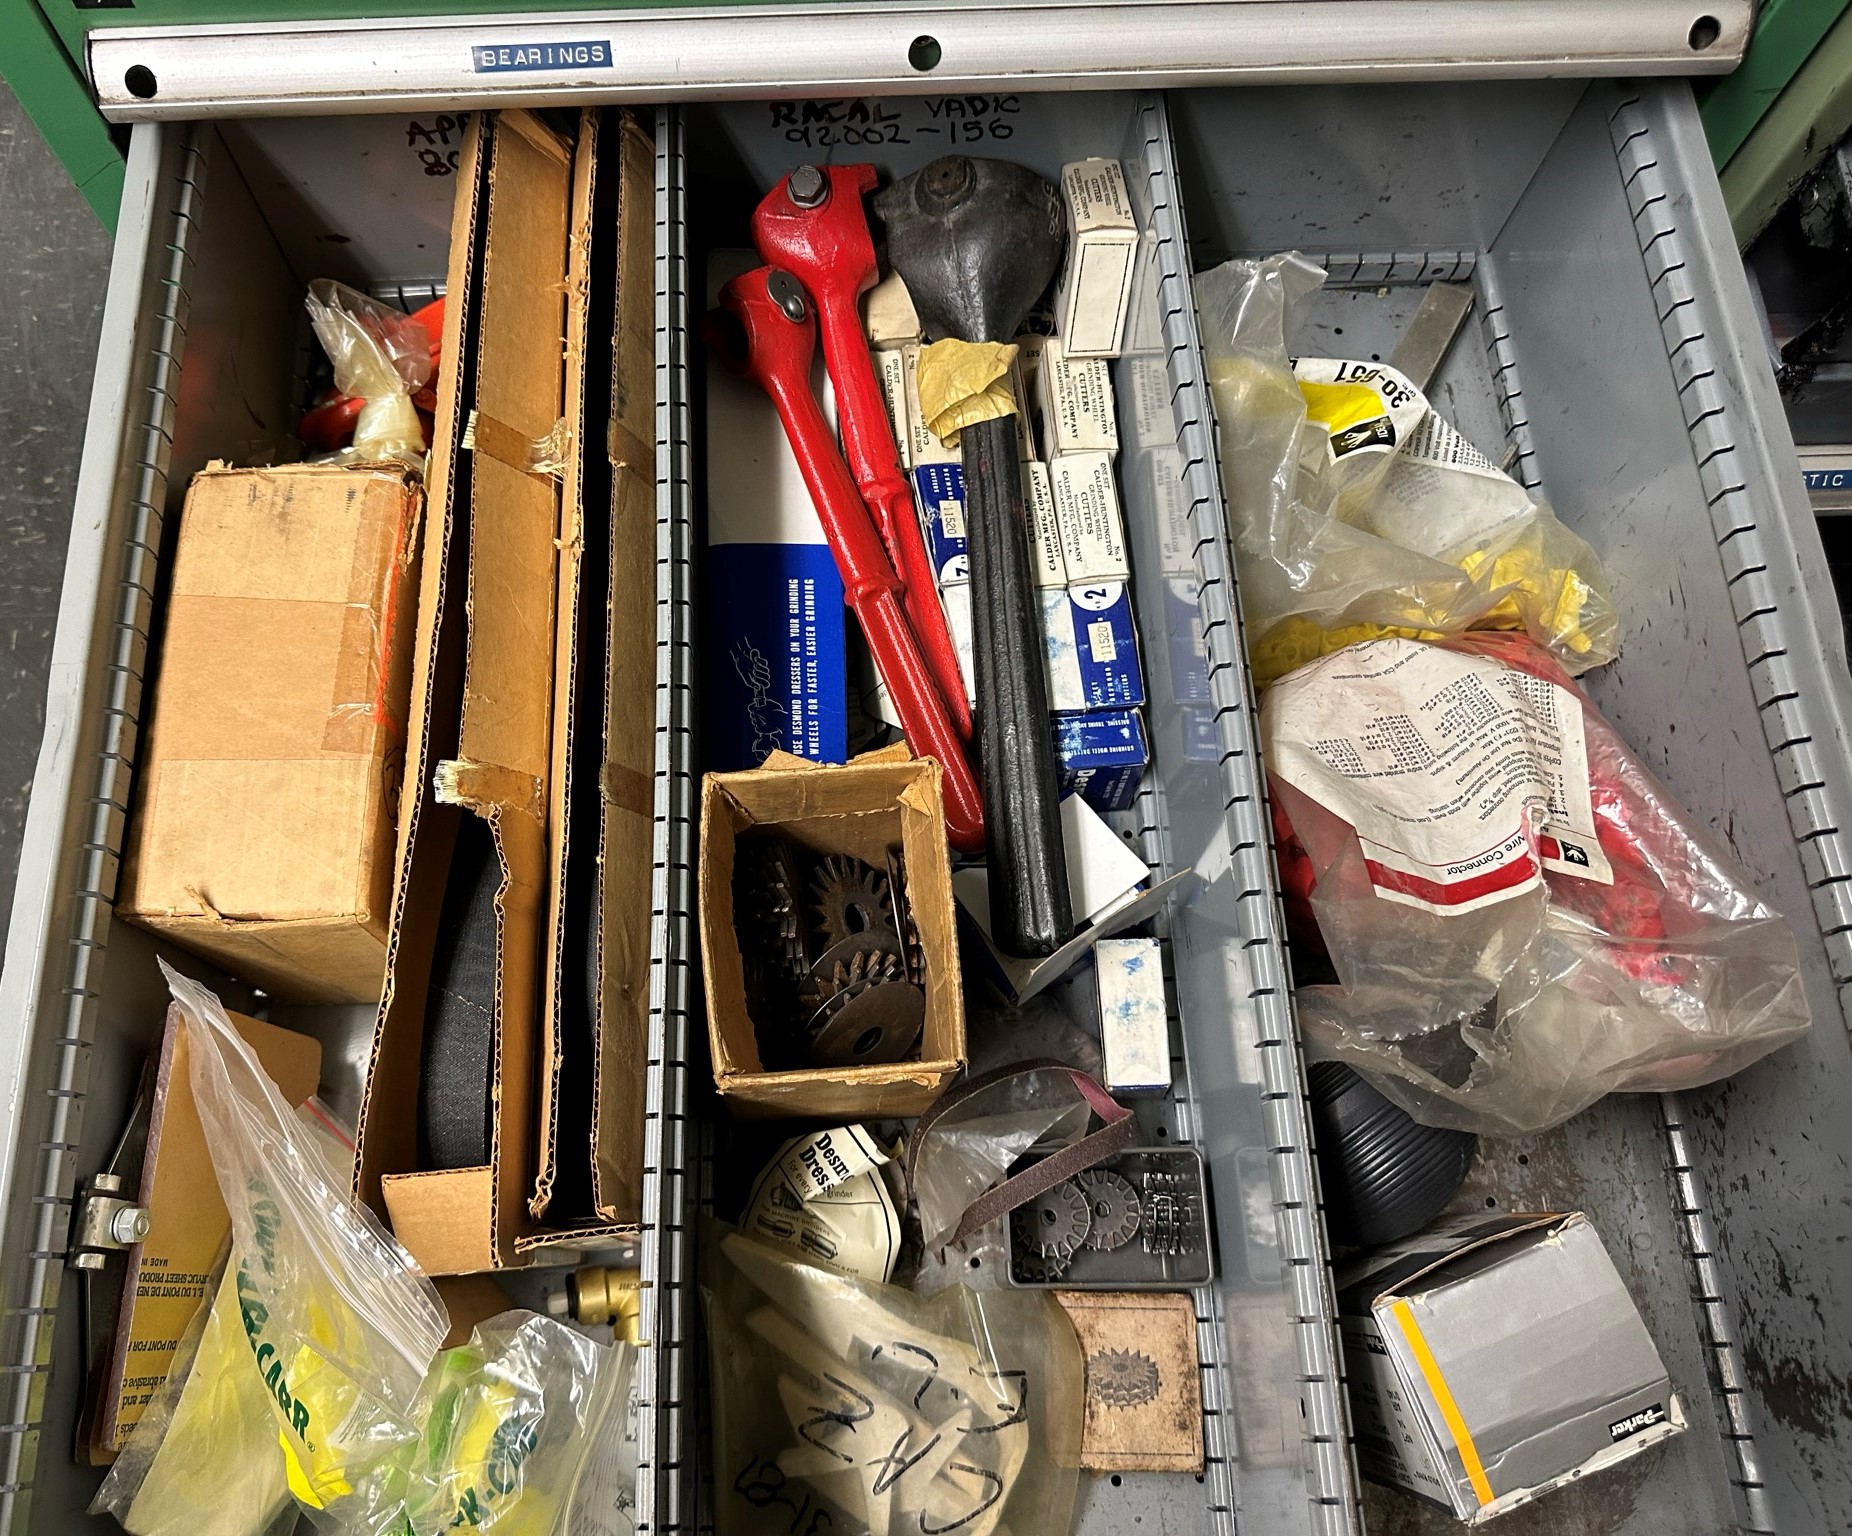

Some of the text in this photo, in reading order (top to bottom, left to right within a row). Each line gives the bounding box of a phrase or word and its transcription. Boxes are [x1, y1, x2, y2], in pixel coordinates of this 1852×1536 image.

[481, 45, 603, 66] BEARINGS
[769, 95, 1020, 127] RACAL VADIC
[1090, 177, 1102, 203] CUTTERS
[1086, 362, 1095, 396] GRINDING
[1334, 360, 1411, 411] 30-651
[1078, 372, 1089, 413] CUTTERS
[1067, 400, 1077, 439] COMPANY
[1423, 430, 1431, 458] Temperature
[929, 468, 939, 492] CUTTERS
[942, 468, 953, 499] DESMOND
[1056, 480, 1067, 519] LANCASTER,
[1073, 494, 1082, 528] Manufactured
[943, 506, 956, 534] 11520
[1031, 469, 1056, 570] CALDER MFG. COMPANY
[1061, 470, 1082, 562] CALDER MFG. COMPANY
[1080, 491, 1093, 534] CUTTERS
[1088, 484, 1102, 541] GRINDING WHEEL
[1093, 469, 1112, 555] CALDER-HUNTINGTON
[1049, 518, 1059, 557] LANCASTER,
[1083, 588, 1106, 599] 2
[1097, 626, 1111, 655] 11520
[788, 578, 802, 754] USE DESMOND DRESSERS ON YOUR GRINDING
[804, 578, 819, 754] WHEELS FOR FASTER, EASIER GRINDING
[1394, 659, 1404, 669] and
[1404, 650, 1418, 662] listed
[1381, 665, 1394, 675] CSA
[1104, 667, 1115, 701] DESMOND
[1475, 732, 1487, 741] Max.
[1480, 739, 1492, 749] Max.
[1436, 741, 1458, 759] following
[1451, 747, 1469, 761] fixtures
[1423, 758, 1436, 769] solid
[1429, 764, 1445, 777] signs.
[1484, 766, 1494, 775] into
[1487, 769, 1502, 781] wires
[1501, 756, 1524, 771] stripped
[1449, 794, 1463, 806] when
[1470, 779, 1488, 797] together
[1502, 778, 1525, 798] removing
[1460, 797, 1470, 808] with
[1479, 797, 1504, 821] connectors.
[1445, 849, 1504, 877] Connector
[787, 1159, 798, 1172] For
[794, 1172, 812, 1195] every
[150, 1257, 167, 1266] MADE
[165, 1273, 186, 1282] SHEET
[188, 1273, 208, 1283] RYLIC
[150, 1286, 190, 1296] DU PONT DE
[131, 1340, 176, 1350] DU PONT FOR
[121, 1395, 137, 1408] and
[1609, 1408, 1654, 1437] Parker
